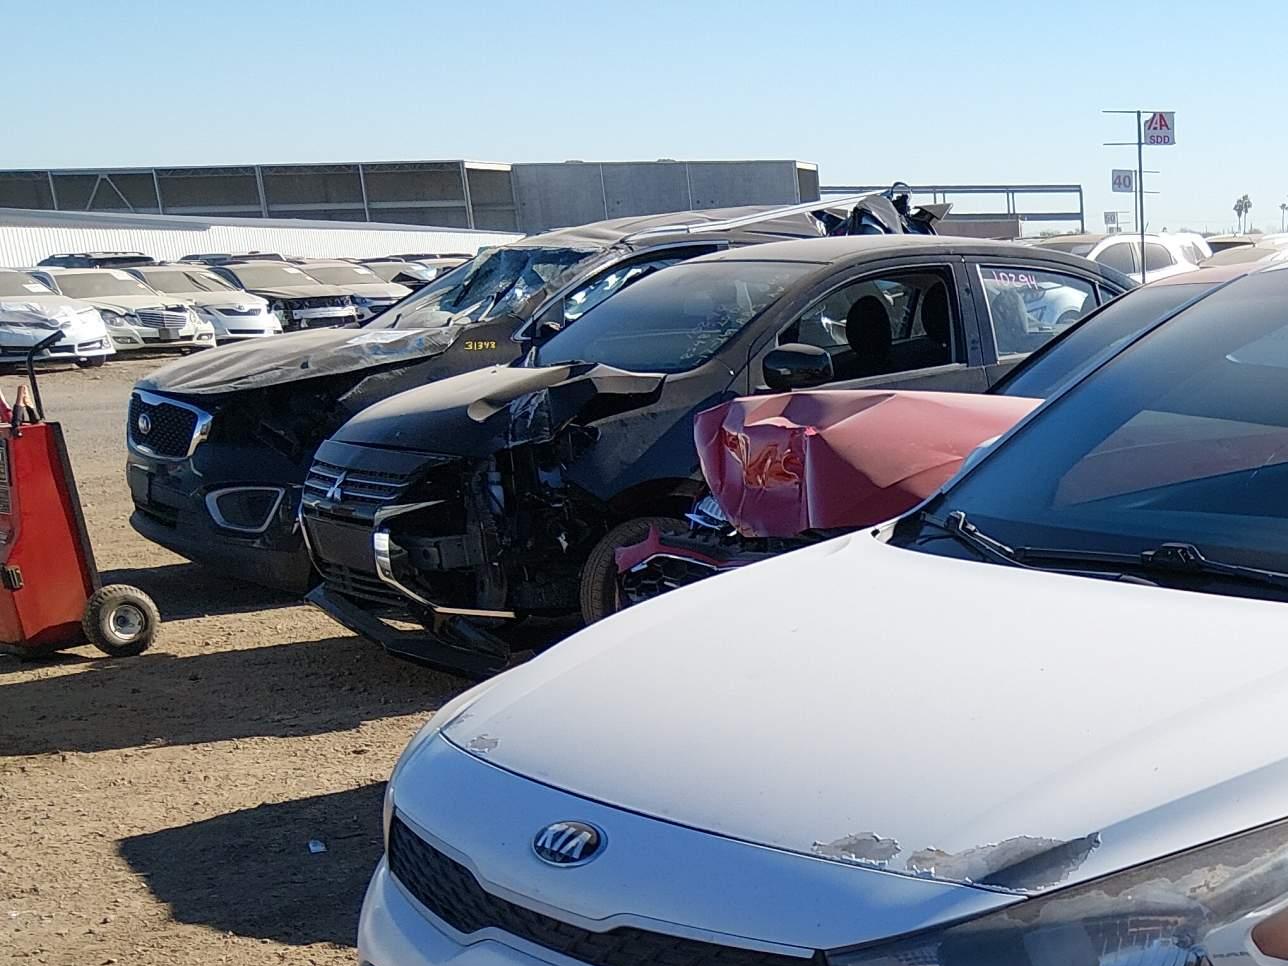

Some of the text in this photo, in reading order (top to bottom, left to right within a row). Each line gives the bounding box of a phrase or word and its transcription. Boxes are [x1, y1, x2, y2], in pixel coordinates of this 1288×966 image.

[1149, 135, 1170, 145] SDD
[1113, 175, 1131, 189] 40
[991, 270, 1039, 290] 10294
[536, 823, 592, 859] KIA
